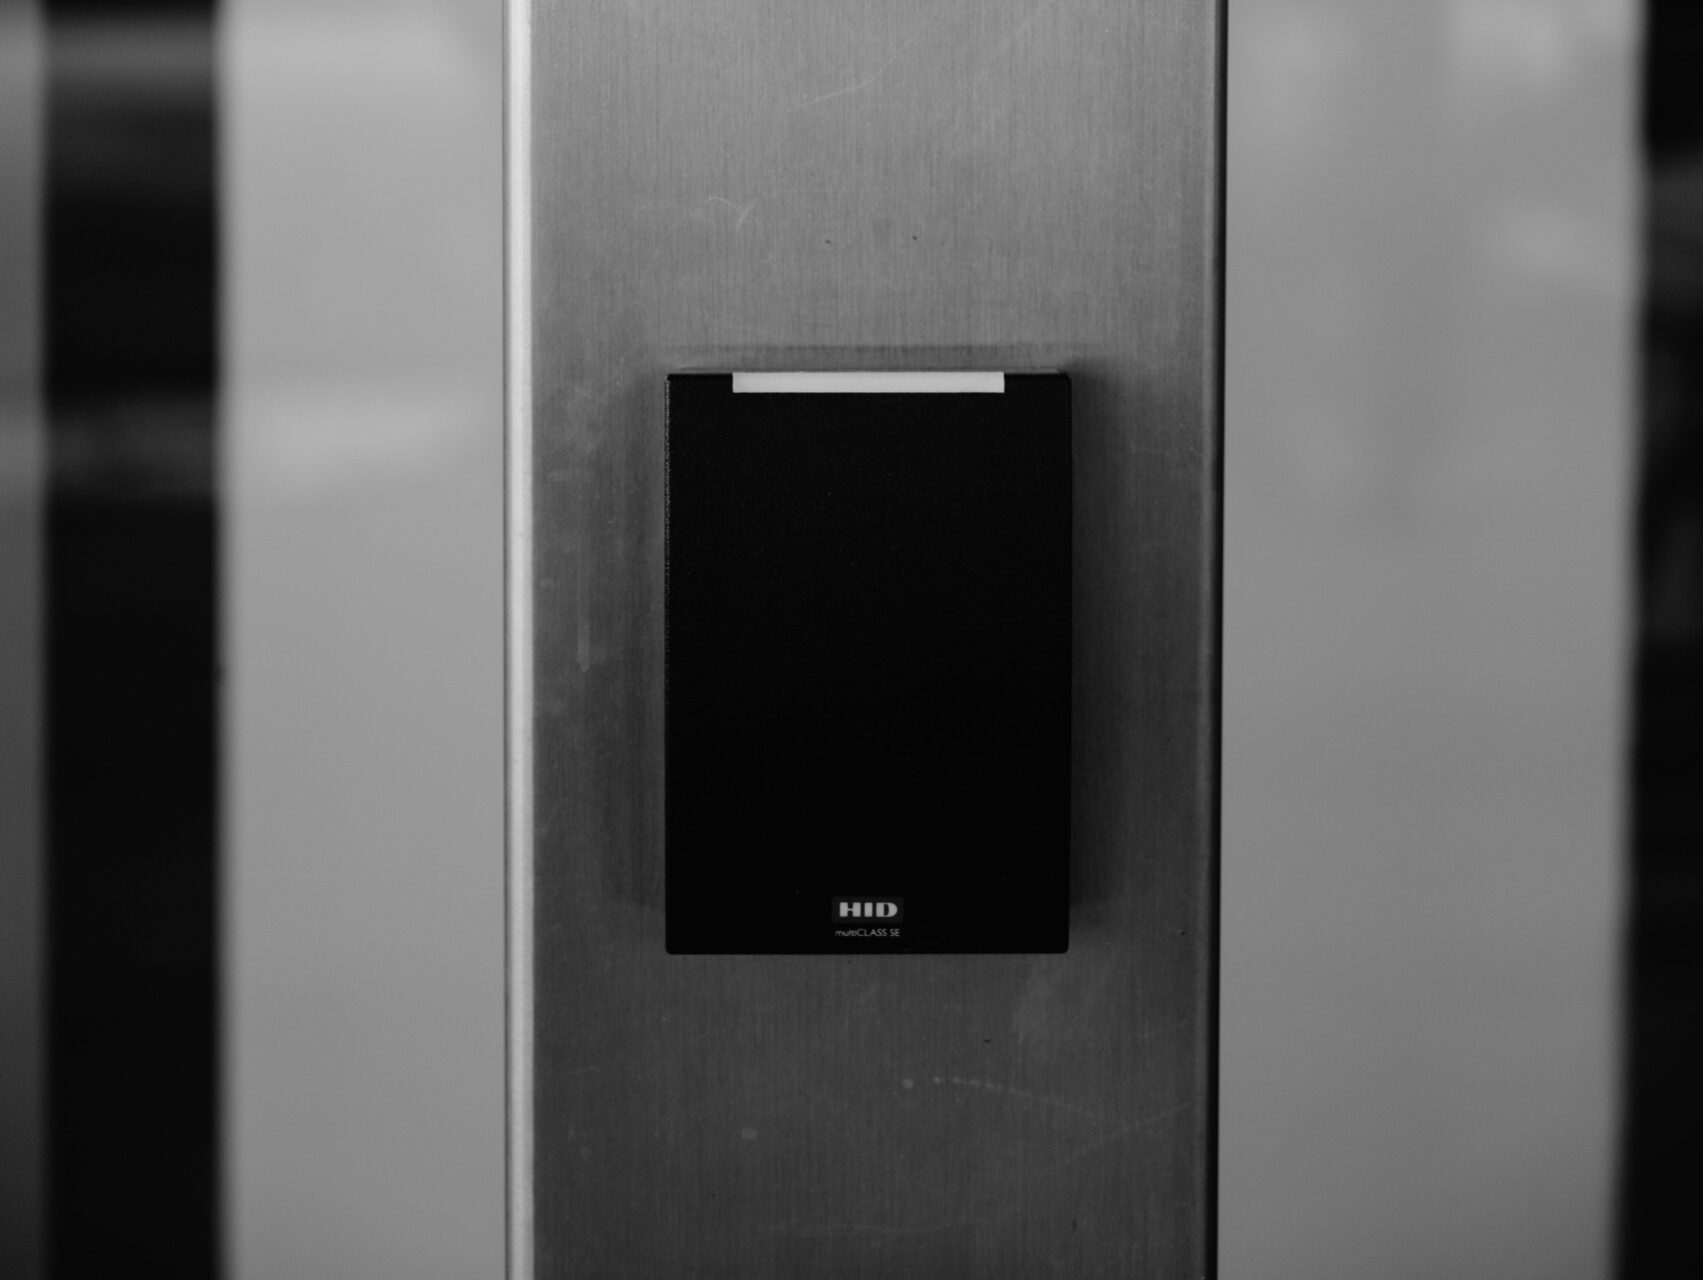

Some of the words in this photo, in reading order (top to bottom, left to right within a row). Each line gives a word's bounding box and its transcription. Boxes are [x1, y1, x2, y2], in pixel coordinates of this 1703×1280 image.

[839, 902, 898, 918] HID
[835, 928, 888, 937] multiCLASS
[889, 928, 900, 937] SE
